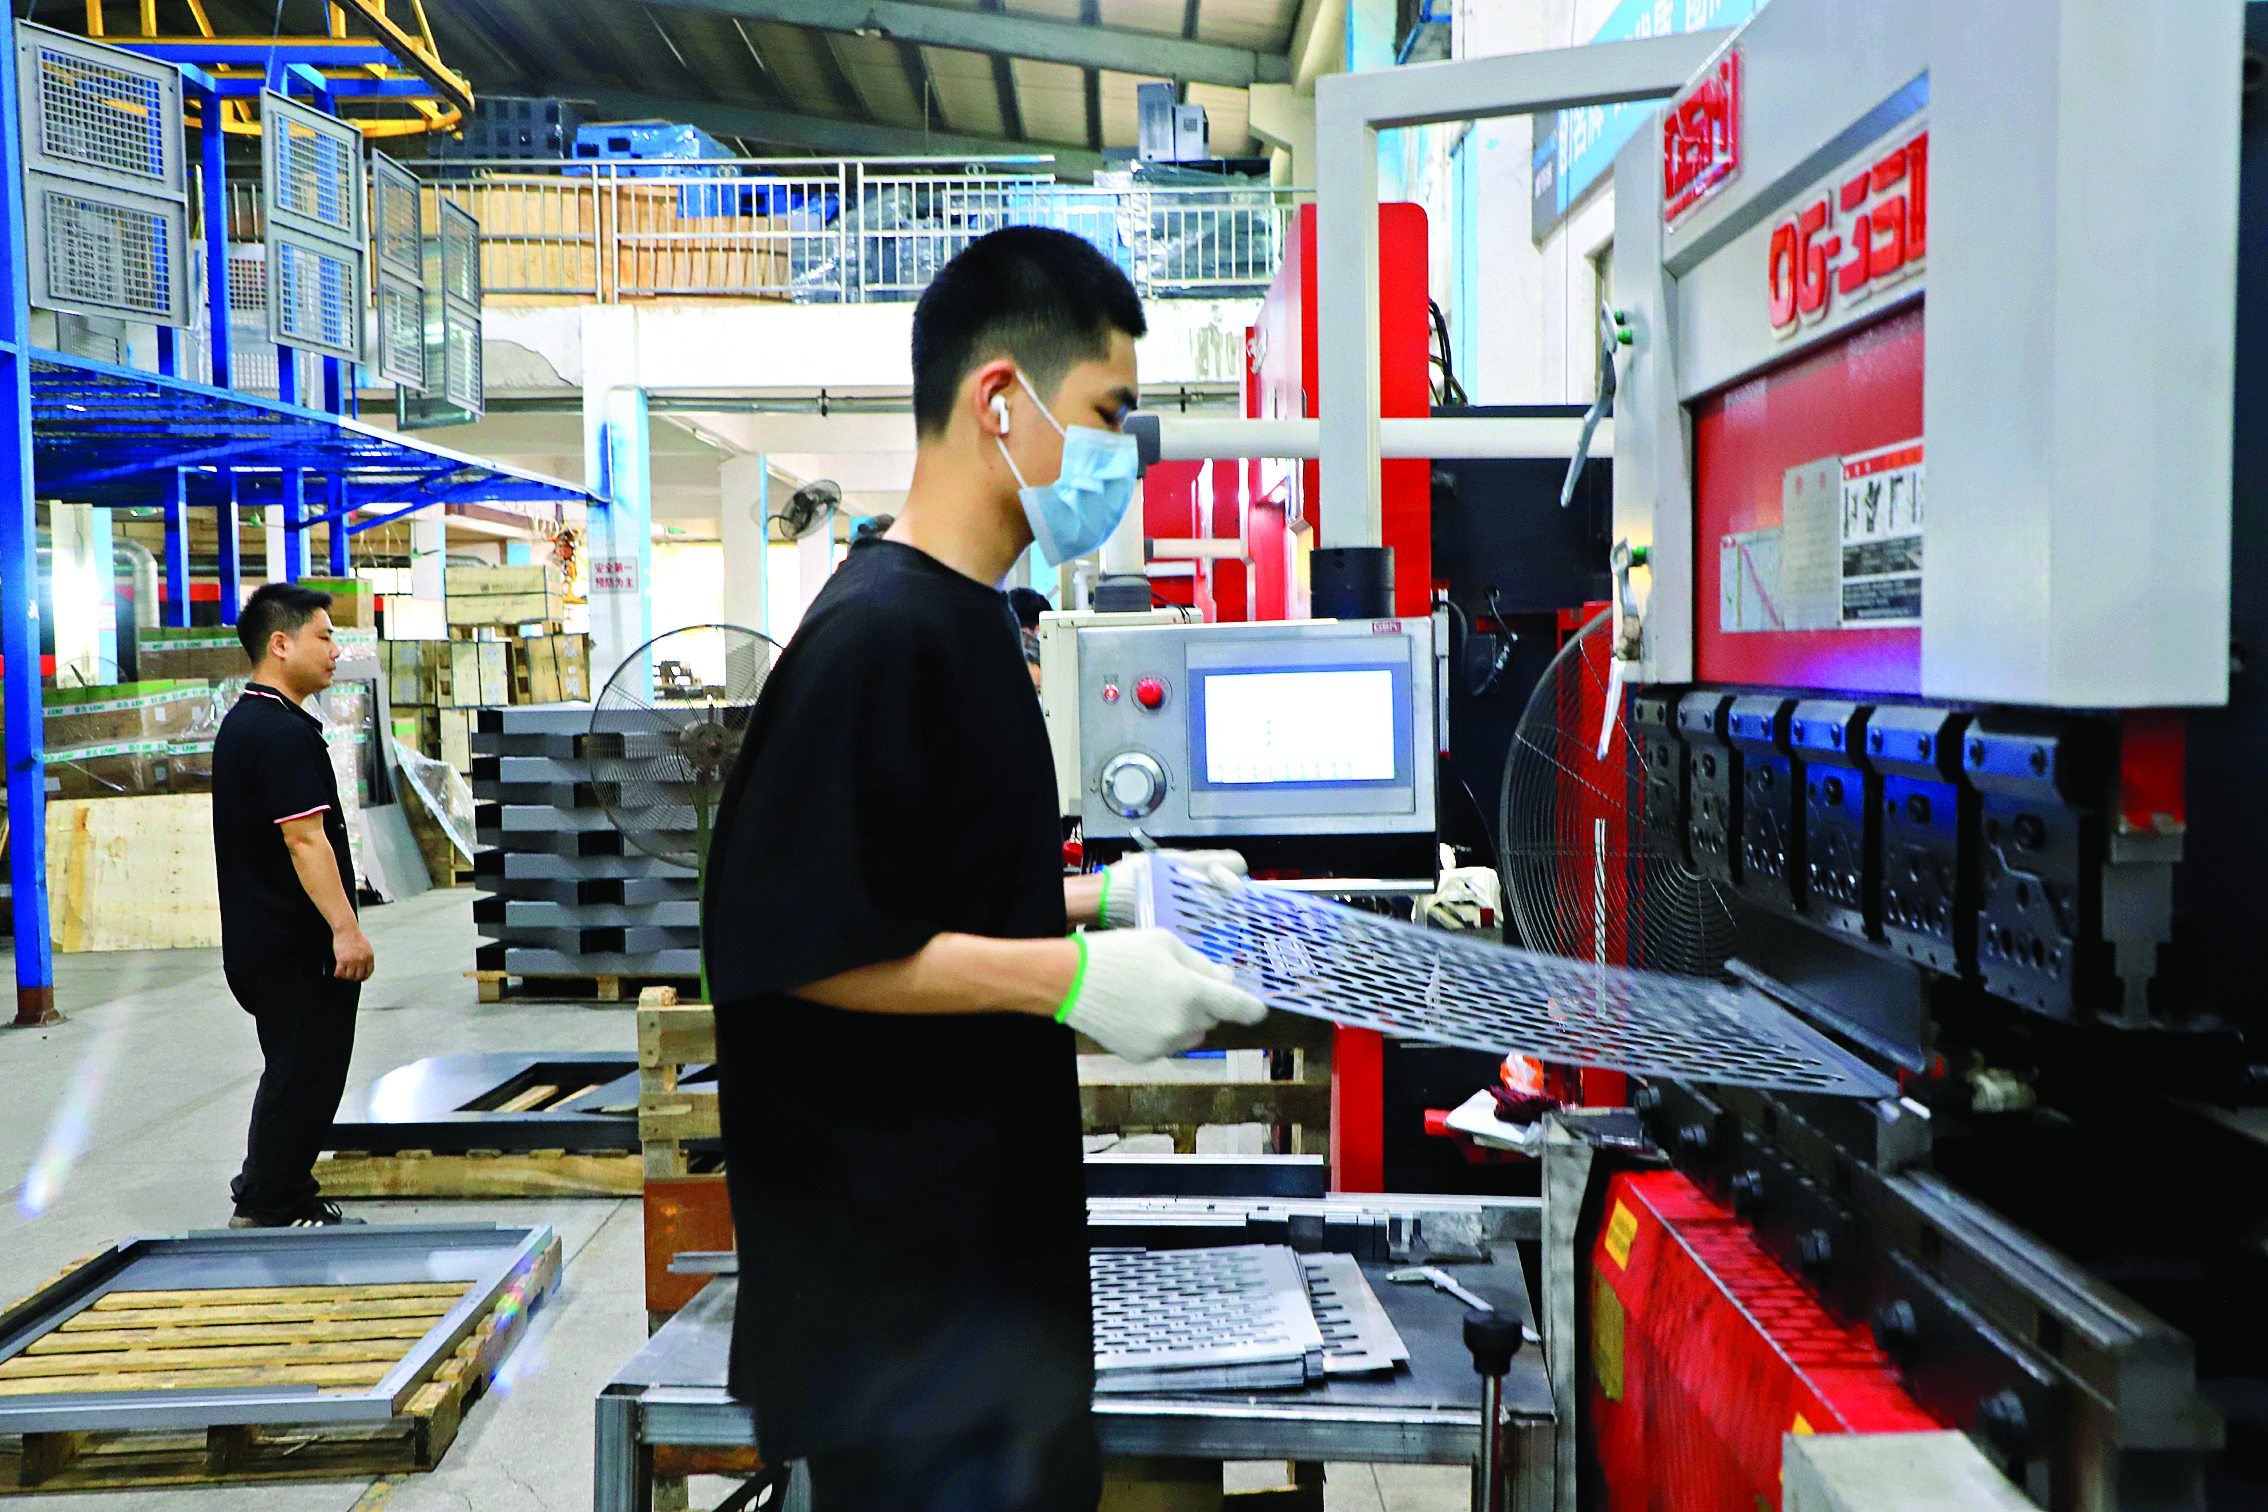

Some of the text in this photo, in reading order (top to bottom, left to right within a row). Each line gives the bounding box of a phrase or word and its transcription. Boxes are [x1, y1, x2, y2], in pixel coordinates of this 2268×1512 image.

[595, 562, 632, 574] 安全第一
[595, 577, 633, 588] 预防为主
